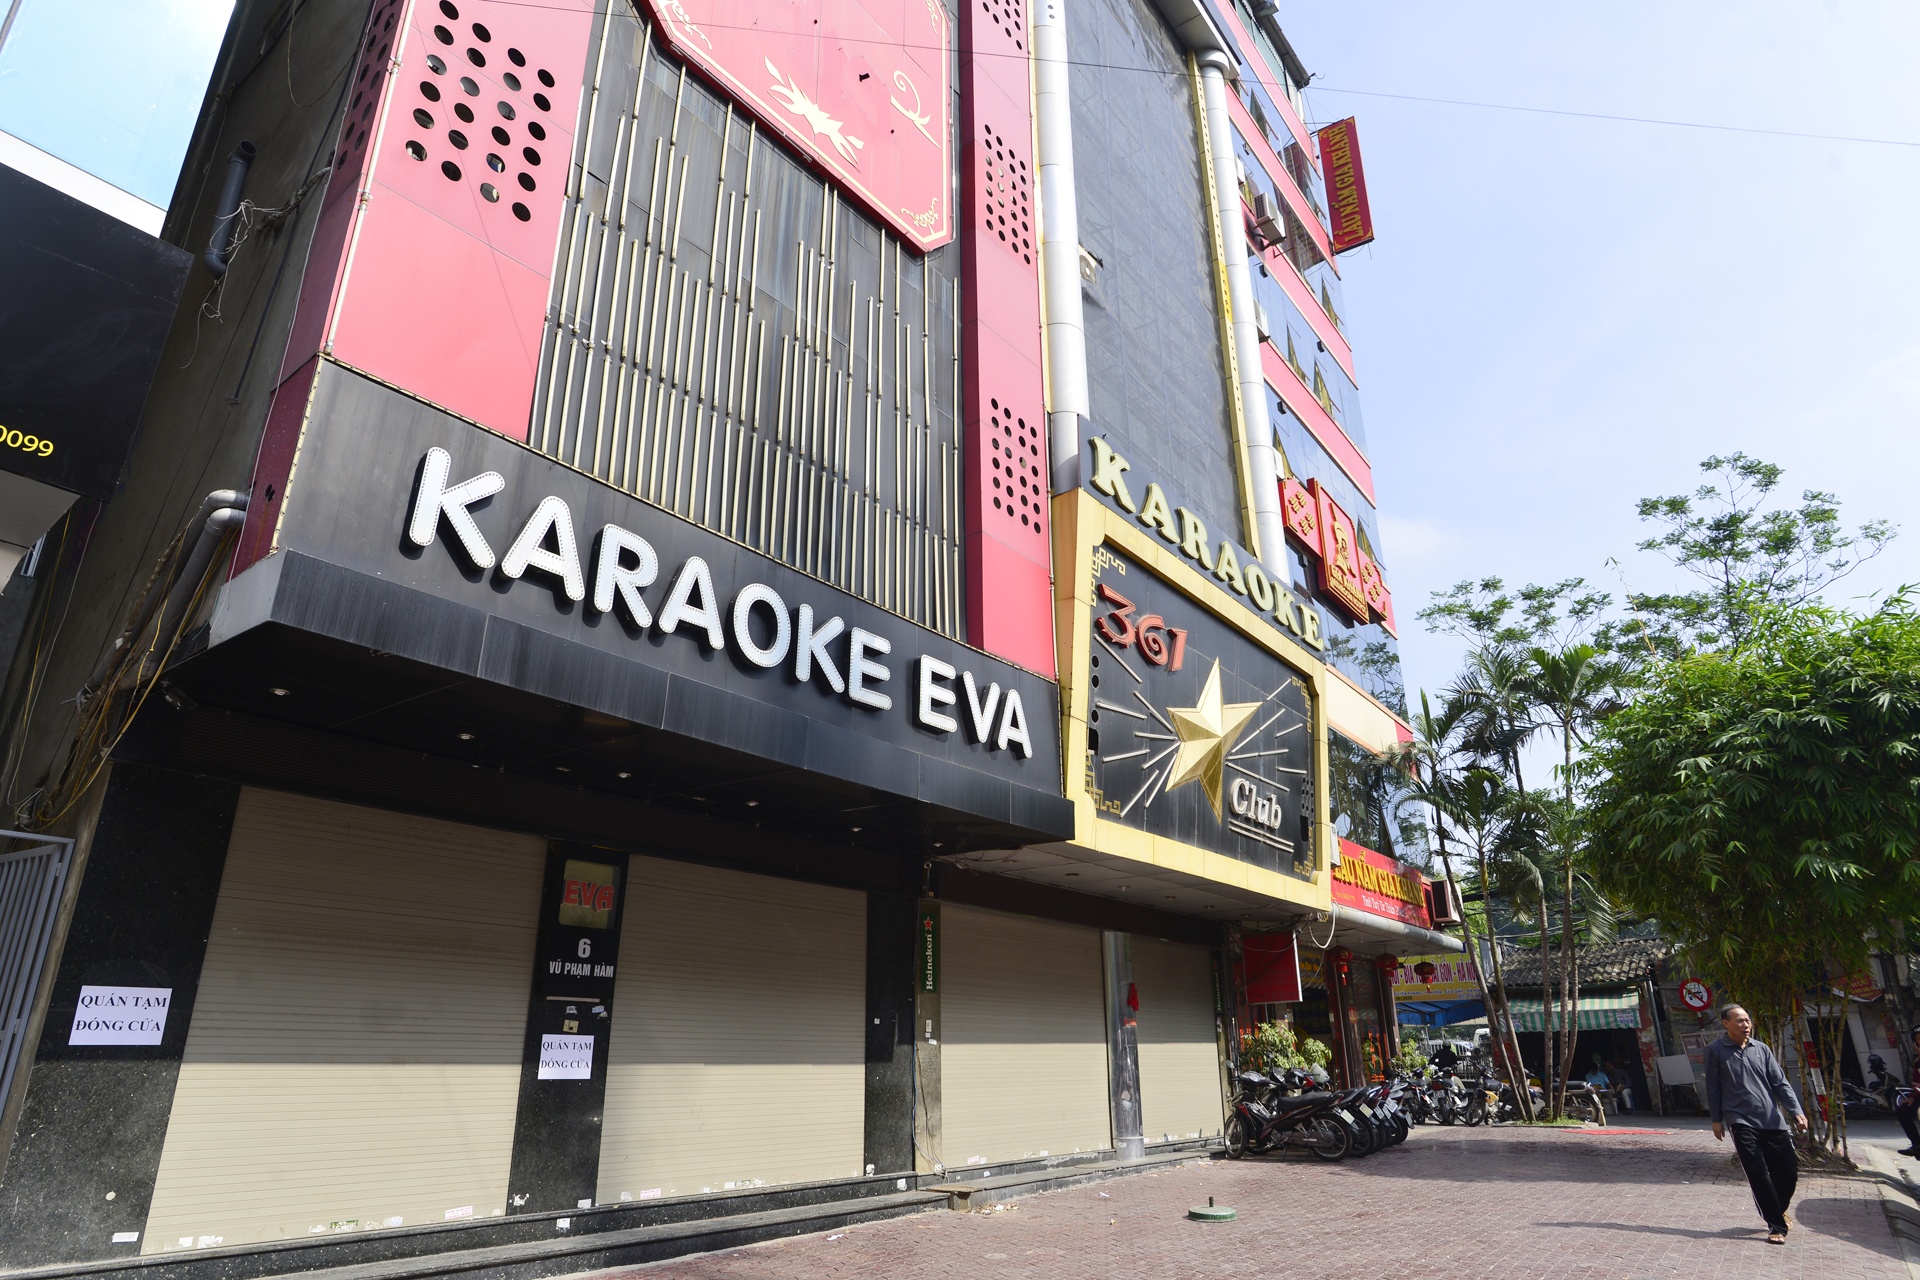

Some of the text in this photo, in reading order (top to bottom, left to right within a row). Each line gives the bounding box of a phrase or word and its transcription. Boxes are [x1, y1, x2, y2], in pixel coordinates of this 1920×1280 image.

[1334, 164, 1355, 189] GIA
[1089, 436, 1325, 652] KARAOKE
[408, 446, 893, 711] KARAOKE
[1095, 583, 1188, 672] 361
[918, 653, 1034, 759] EVA
[1230, 778, 1282, 830] Club
[562, 879, 615, 912] EVA
[1377, 868, 1398, 899] GIA
[577, 938, 591, 958] 6
[925, 933, 933, 990] Heineken
[549, 958, 614, 979] VŨ PHẠM HÀM
[1456, 958, 1466, 982] HÀ
[81, 993, 168, 1010] QUÁN TẠM
[75, 1017, 162, 1032] ĐÓNG CỬA
[542, 1039, 592, 1053] QUÁN TẠM
[570, 1058, 590, 1070] CỬA
